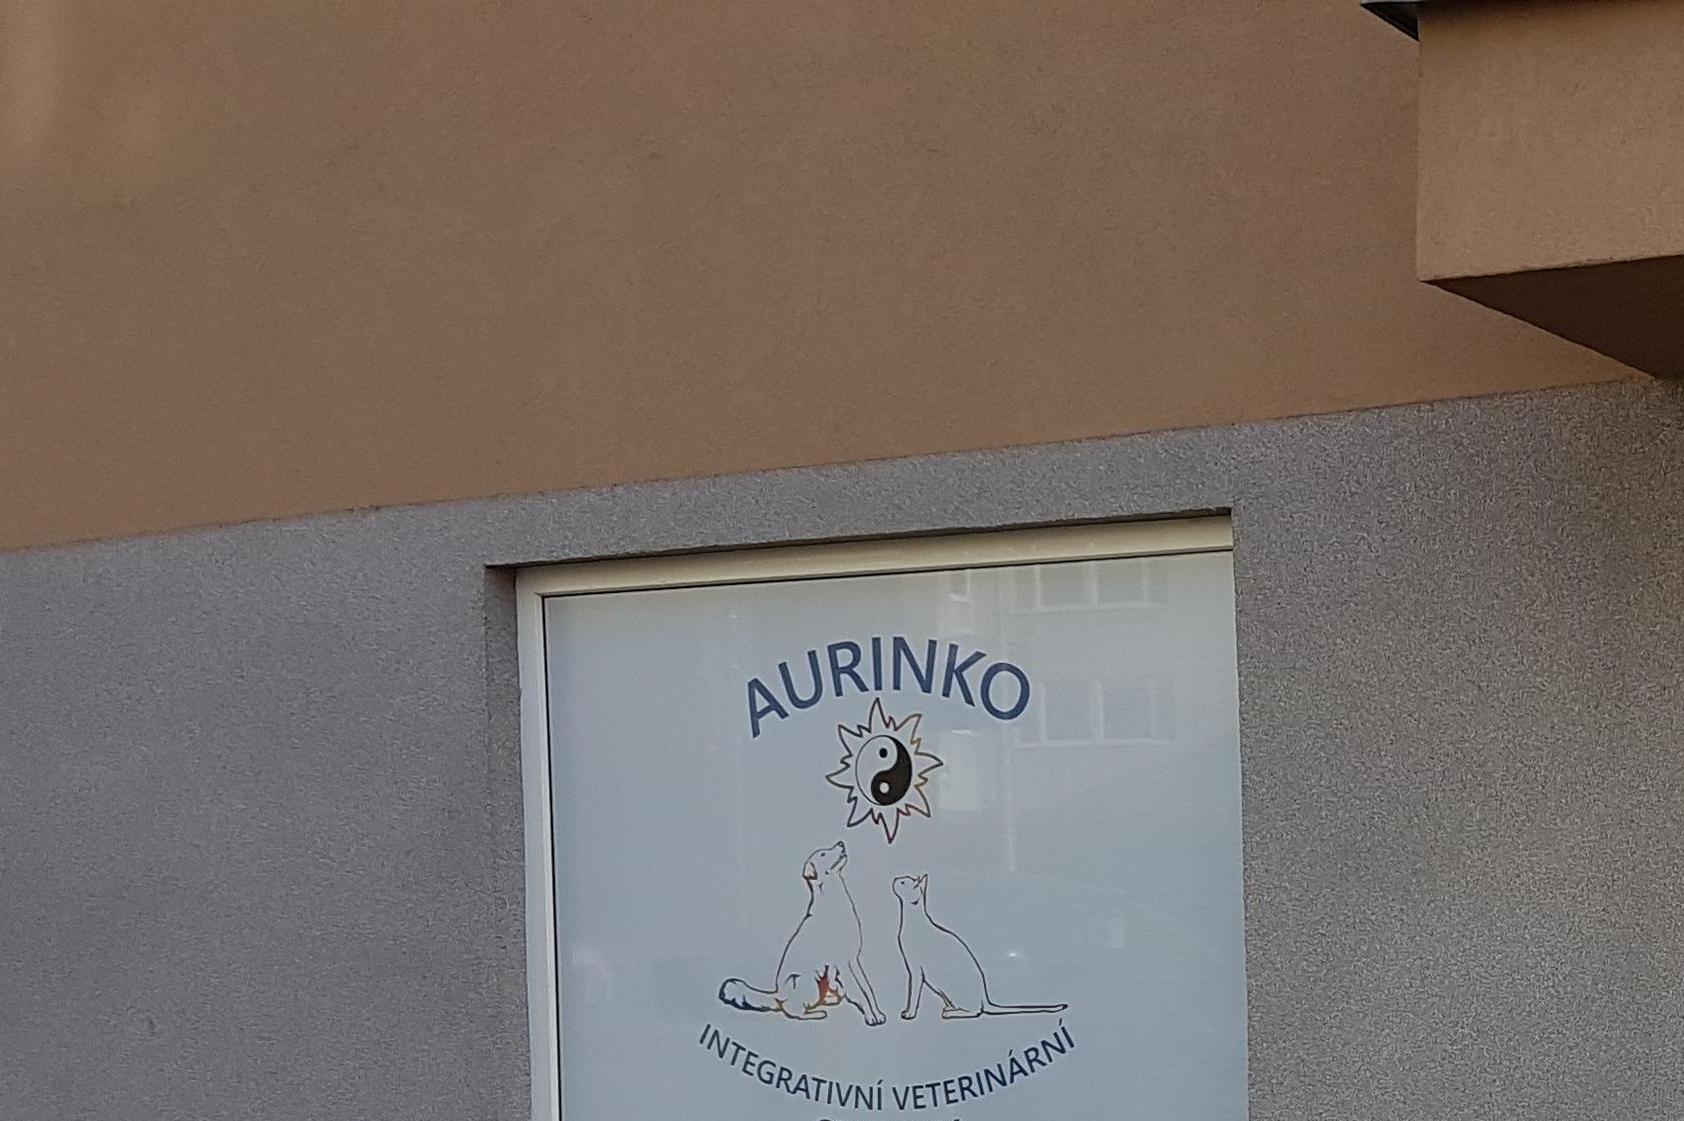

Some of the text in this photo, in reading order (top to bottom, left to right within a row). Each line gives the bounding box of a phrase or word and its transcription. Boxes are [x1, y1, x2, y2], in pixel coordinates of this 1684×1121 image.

[744, 636, 1031, 738] AURINKO
[699, 1019, 1076, 1110] INTEGRATIVNÍ VETERINÁRNÍ
